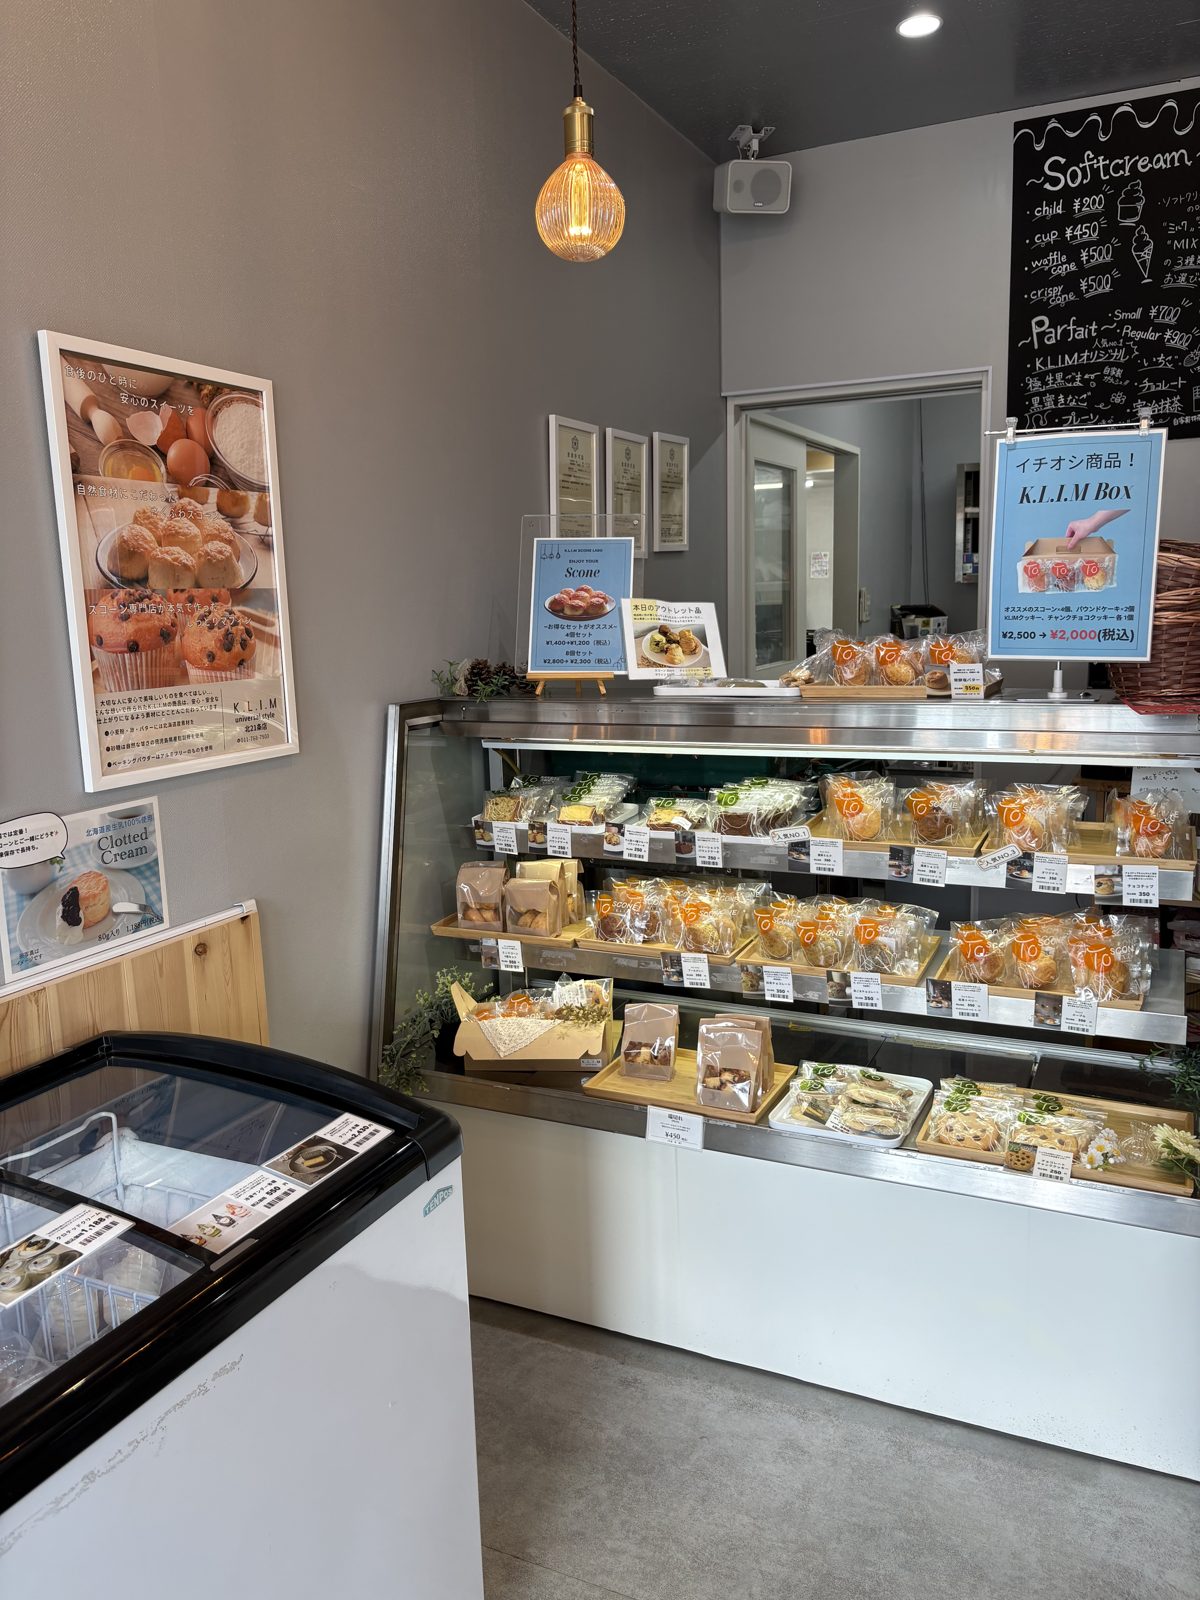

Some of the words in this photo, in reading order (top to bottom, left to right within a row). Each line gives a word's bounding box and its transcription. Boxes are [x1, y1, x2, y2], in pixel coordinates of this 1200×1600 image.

[1043, 149, 1192, 191] Softcream
[1035, 199, 1063, 216] child
[1073, 194, 1104, 213] ¥200
[1035, 230, 1058, 244] cup
[1065, 222, 1098, 240] ¥450
[1032, 251, 1067, 267] waffle
[1080, 244, 1112, 264] ¥500
[1051, 262, 1077, 275] cone
[1030, 285, 1063, 300] crispy
[1080, 275, 1111, 293] ¥500
[1049, 292, 1076, 305] cone
[1114, 307, 1143, 320] Small
[1149, 305, 1182, 322] ¥700
[1031, 315, 1098, 349] Parfait
[1122, 325, 1162, 340] Regular
[1164, 328, 1192, 347] ¥900
[64, 364, 138, 389] 食後のひと時に
[1138, 376, 1187, 391] チョコレート
[119, 392, 194, 416] 安心のスイーツを
[1018, 482, 1091, 504] K.L.I.M
[1094, 482, 1134, 501] Box
[565, 567, 600, 578] Scone
[632, 604, 702, 614] 本日のアウトレット品
[98, 827, 148, 851] Clotted
[101, 844, 148, 865] Cream
